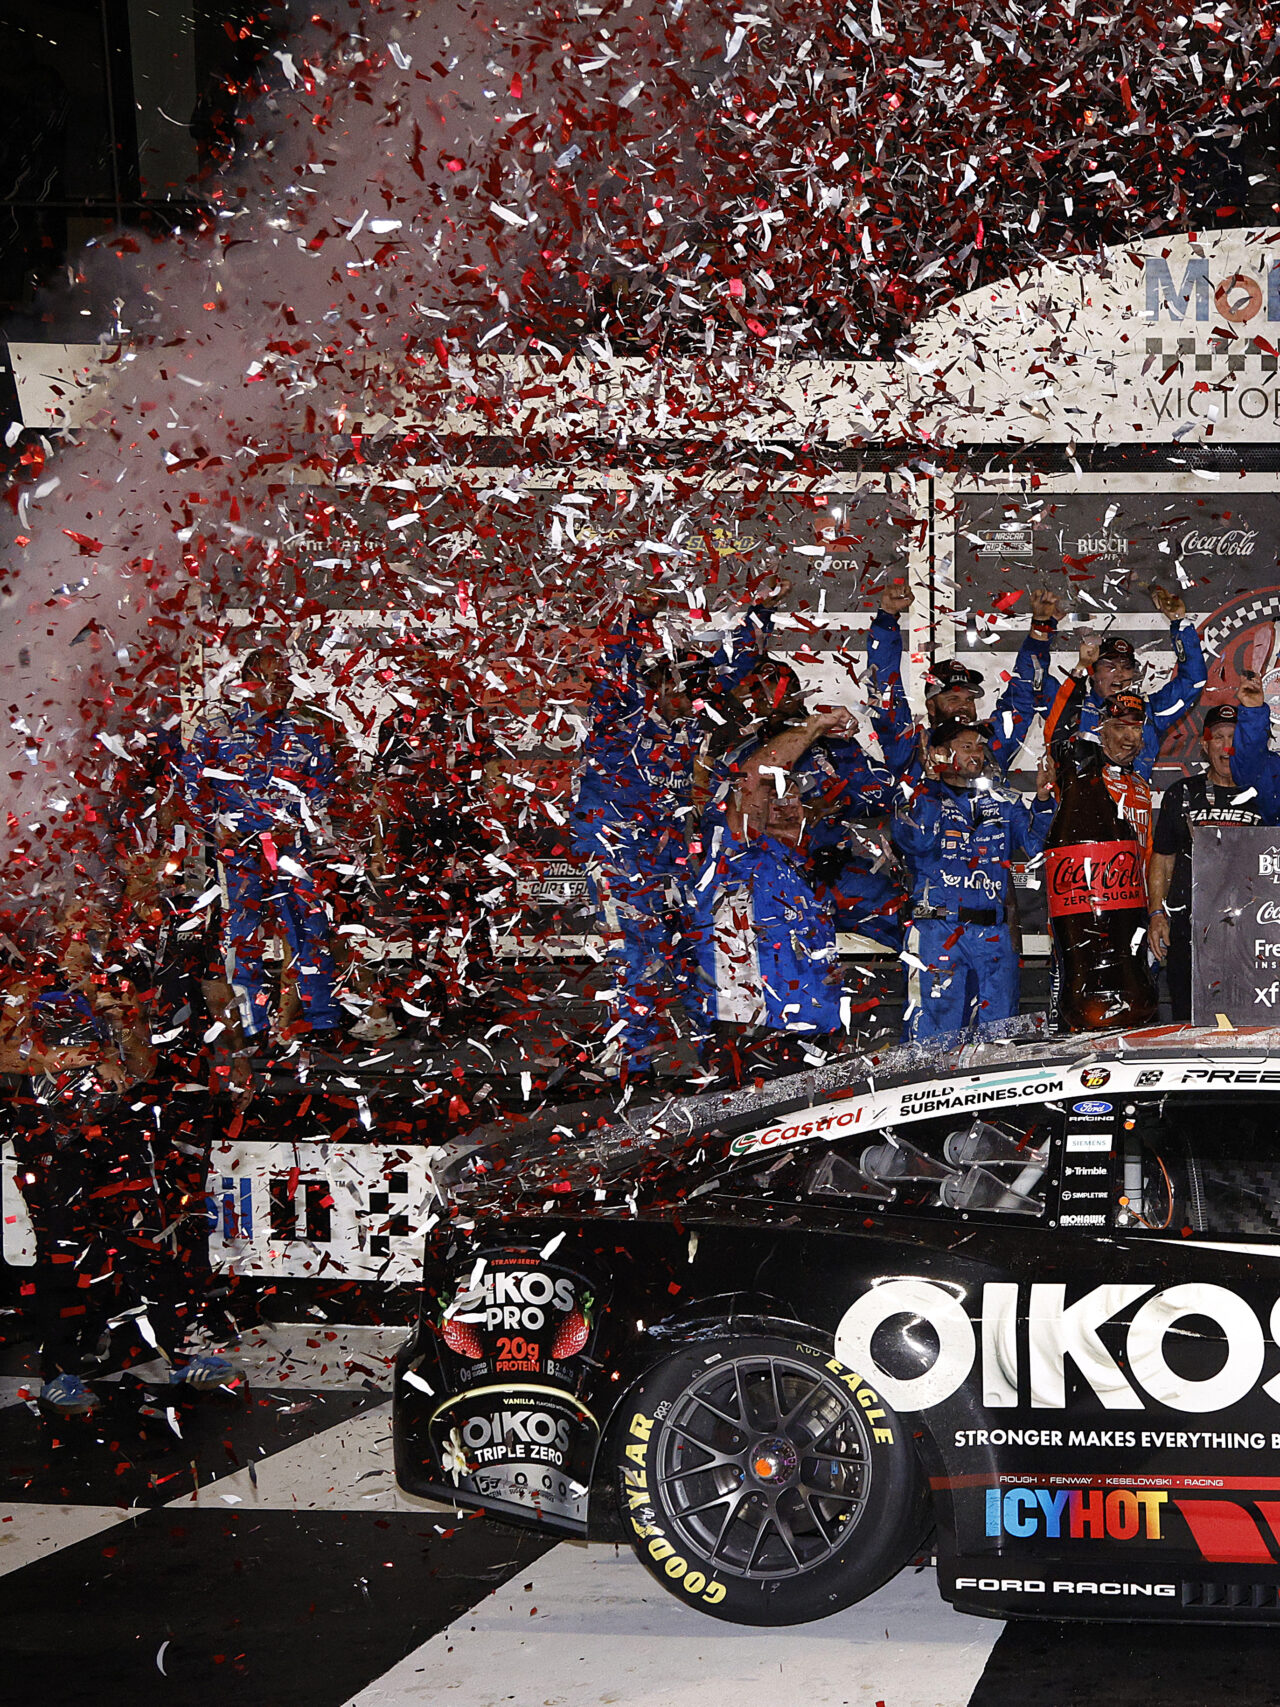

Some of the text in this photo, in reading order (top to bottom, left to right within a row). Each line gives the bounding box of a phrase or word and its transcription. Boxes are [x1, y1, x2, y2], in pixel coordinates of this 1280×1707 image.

[1077, 538, 1129, 554] BUSCH
[1181, 530, 1259, 556] Coca-Cola
[1102, 890, 1140, 902] SUGAR
[899, 1080, 1064, 1117] SUBMARINES.COM
[901, 1086, 955, 1104] BUILD
[759, 1106, 865, 1146] Castrol
[1072, 1139, 1106, 1147] SIEMENS
[1074, 1166, 1107, 1175] Trimble
[1060, 1214, 1106, 1224] MOHAWK
[490, 1258, 541, 1267] STRAWBERRY
[455, 1271, 576, 1312] OIKOS
[486, 1307, 545, 1331] PRO
[496, 1336, 540, 1362] 20g
[496, 1360, 540, 1373] PROTEIN
[503, 1398, 535, 1406] VANILLA
[824, 1358, 895, 1446] EAGLE
[462, 1410, 571, 1452] OIKOS
[954, 1429, 1063, 1448] STRONGER
[1068, 1430, 1136, 1448] MAKES
[1141, 1431, 1266, 1449] EVERYTHING
[474, 1444, 563, 1466] TRIPLE ZERO
[1000, 1475, 1224, 1487] ROUSH FENWAY KESELOWSKI RACING
[955, 1577, 1176, 1597] FORD RACING
